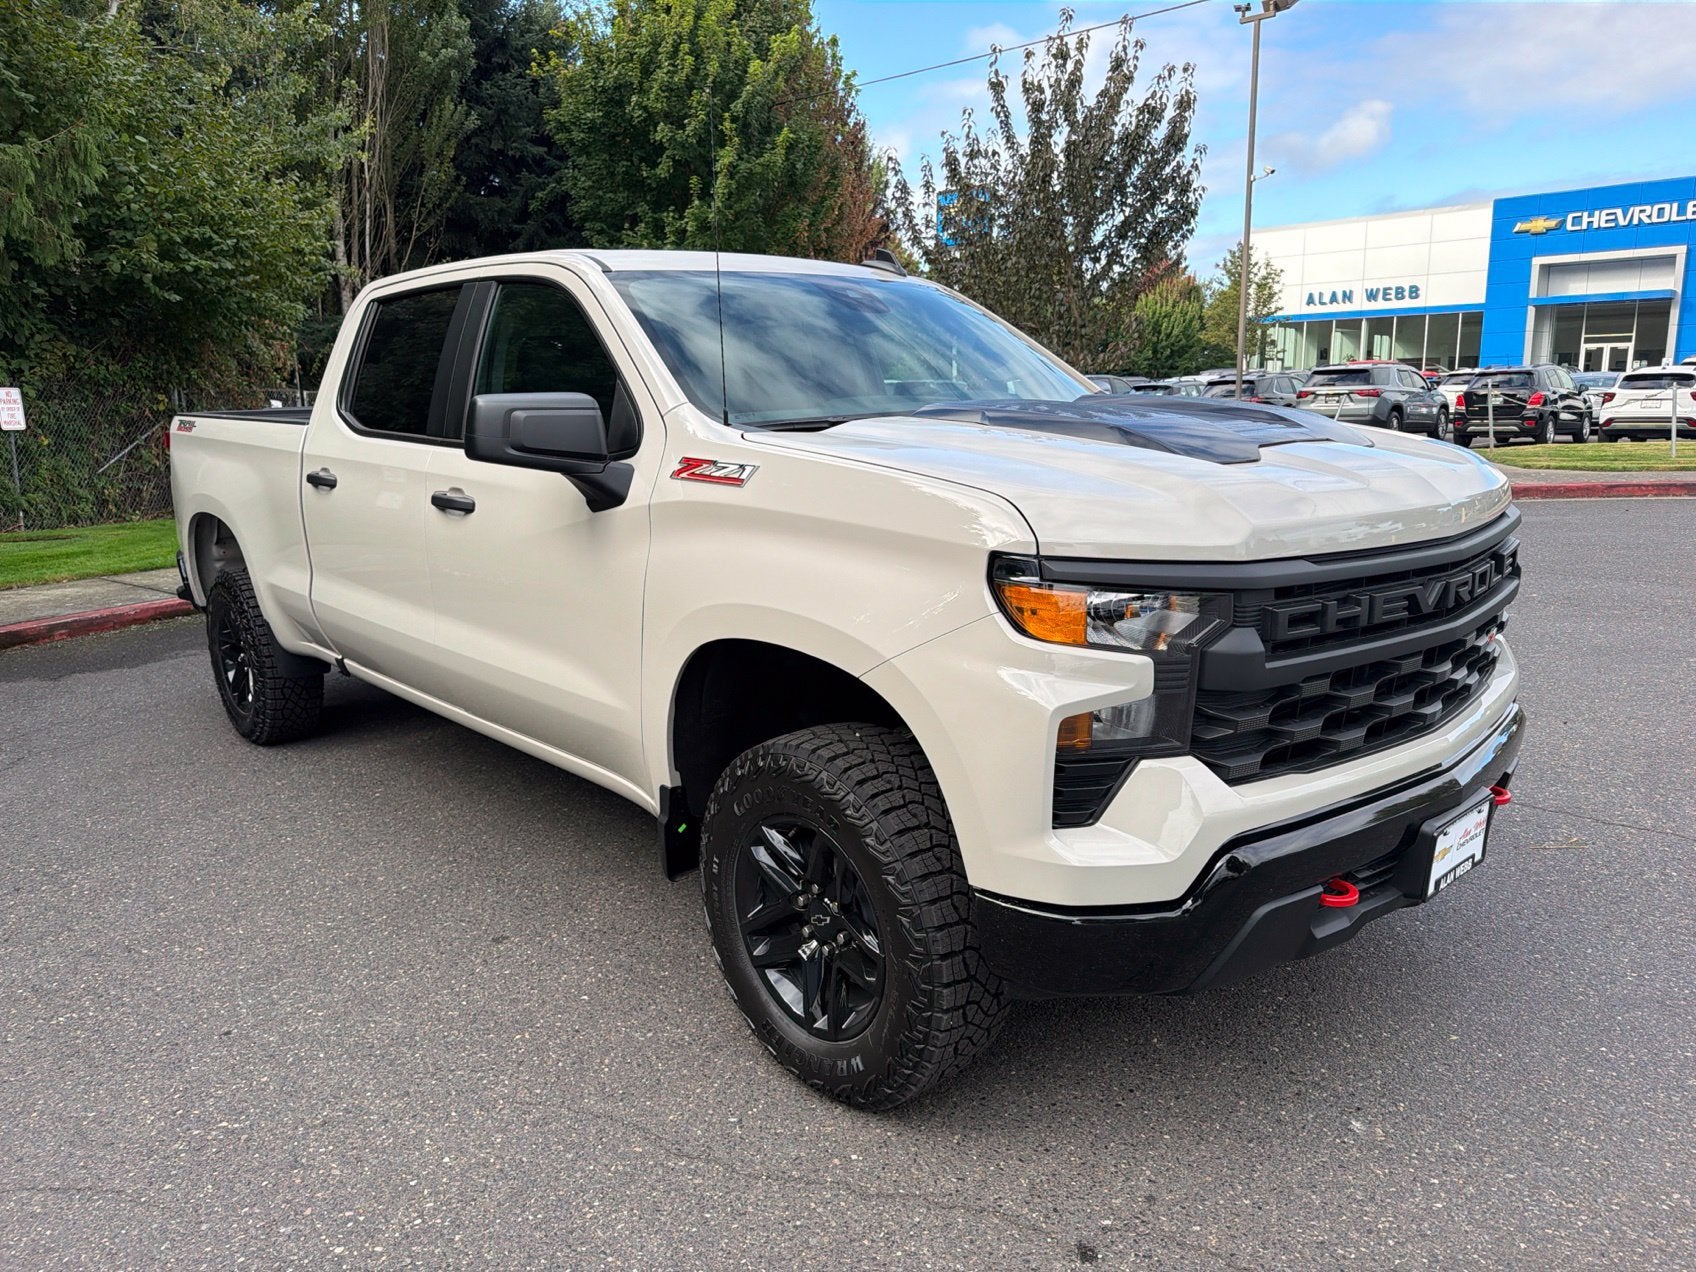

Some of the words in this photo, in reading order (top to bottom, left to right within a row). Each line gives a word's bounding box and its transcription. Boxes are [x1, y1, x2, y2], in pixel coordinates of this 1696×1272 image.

[1305, 289, 1354, 307] ALAN
[1365, 284, 1421, 303] WEBB
[178, 419, 197, 428] TRAIL
[670, 456, 760, 488] Z71
[1438, 869, 1456, 892] ALAN
[1455, 857, 1474, 879] WEBB
